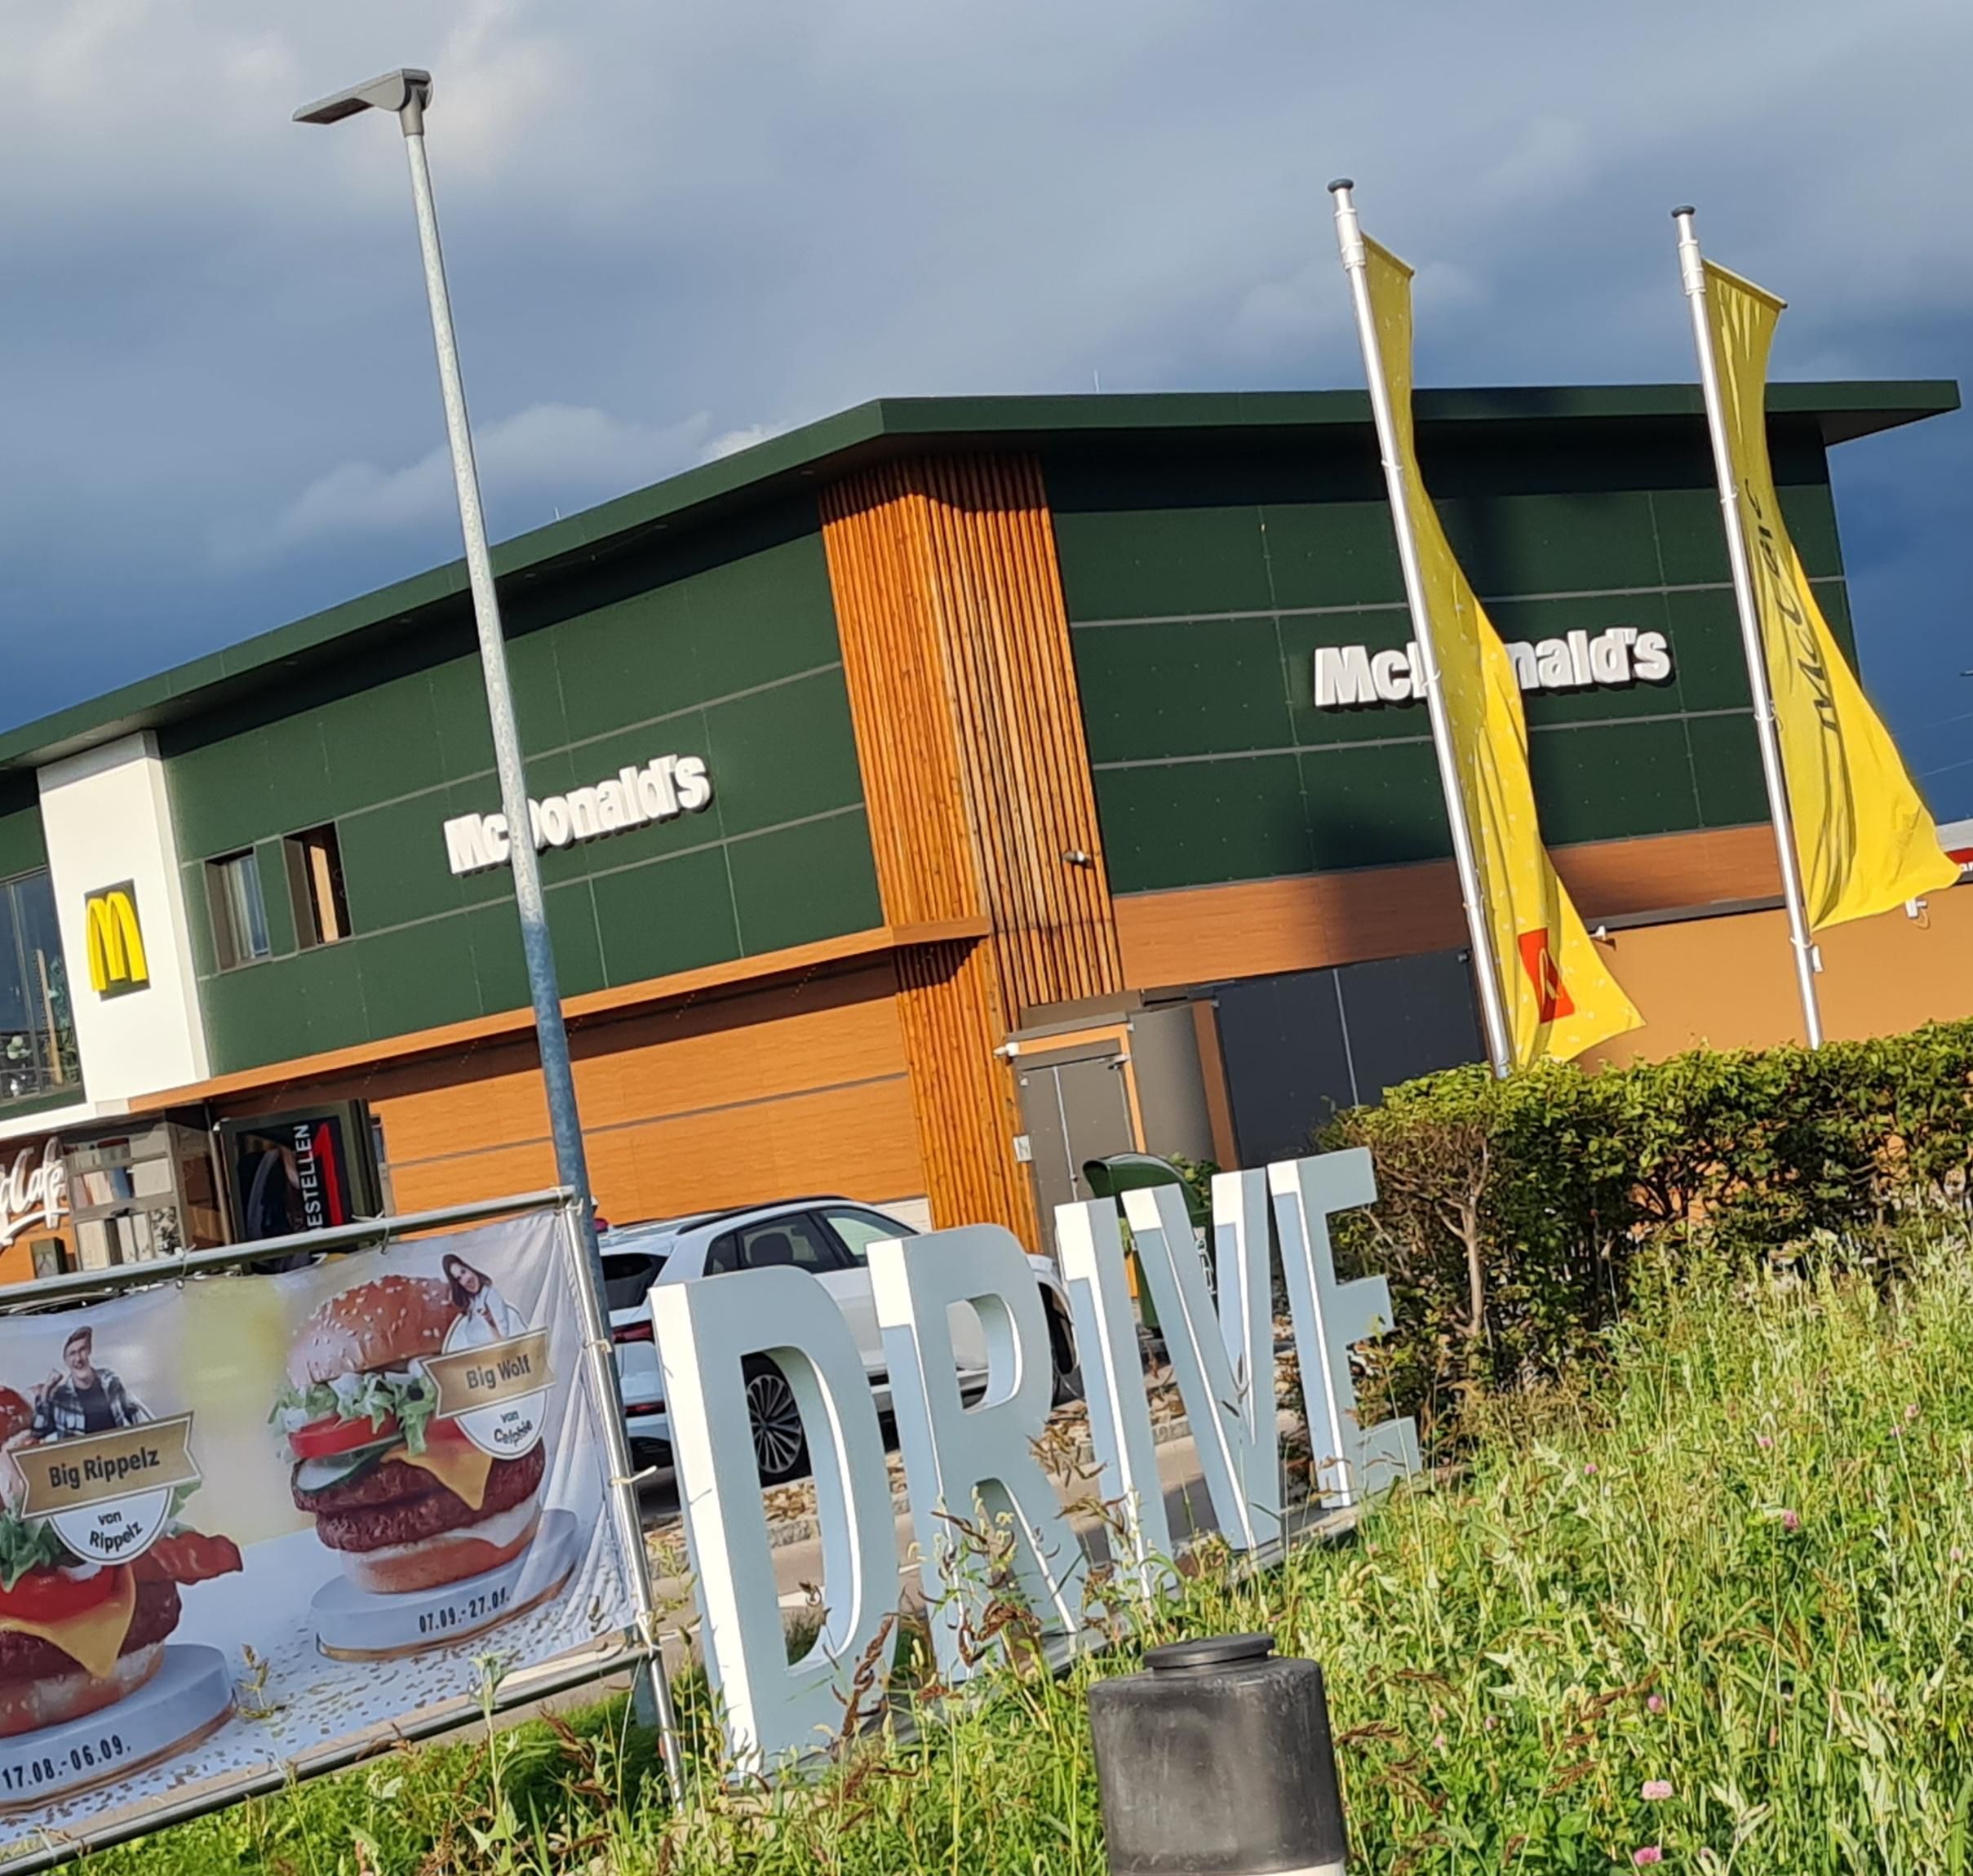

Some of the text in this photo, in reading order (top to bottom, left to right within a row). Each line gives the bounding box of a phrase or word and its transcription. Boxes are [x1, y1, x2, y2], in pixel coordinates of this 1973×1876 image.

[1315, 627, 1671, 707] Mcnald's
[292, 1124, 325, 1229] ESTELLEN
[466, 1353, 531, 1389] Big Wolf
[500, 1410, 520, 1424] von
[48, 1446, 161, 1490] Big Rippelz
[649, 1146, 1421, 1783] DRIVE
[89, 1521, 144, 1554] Rippelz
[97, 1510, 122, 1526] von
[2, 1734, 131, 1790] 17.08.-06.09.
